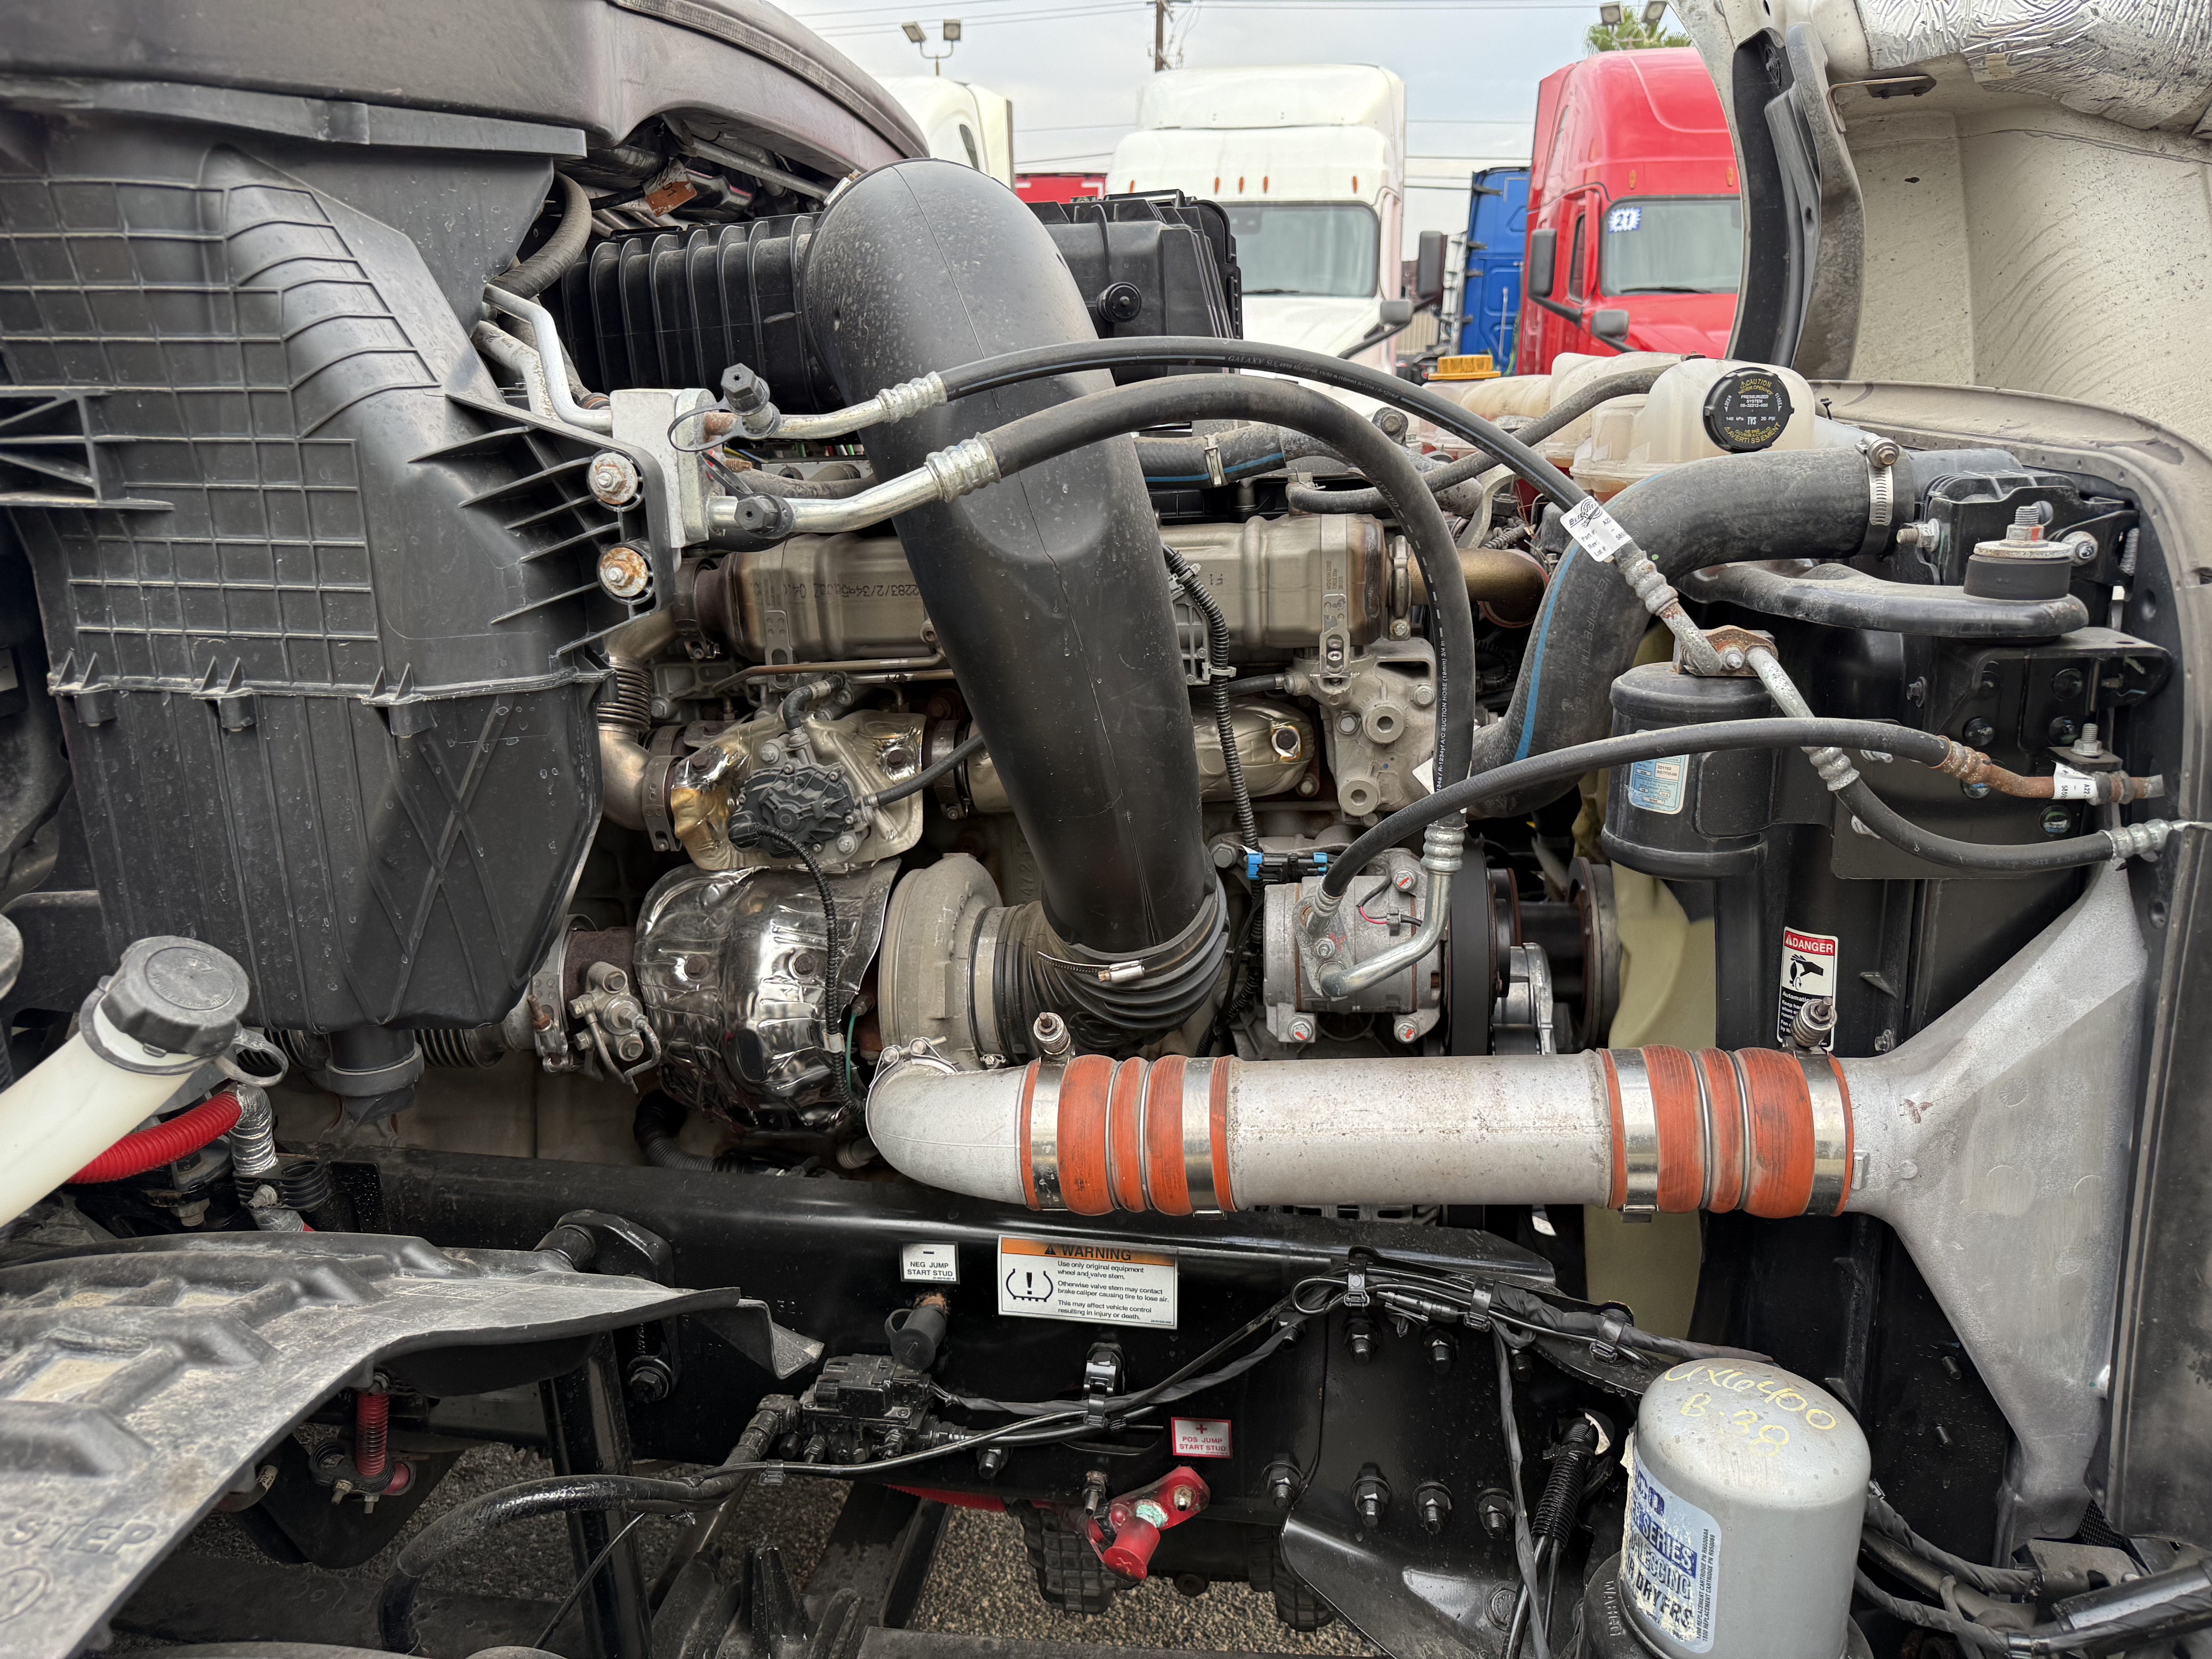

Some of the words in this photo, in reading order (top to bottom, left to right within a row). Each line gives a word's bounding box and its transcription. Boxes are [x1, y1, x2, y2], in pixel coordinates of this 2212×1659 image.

[1616, 213, 1633, 228] 21
[1228, 355, 1264, 365] GALAXY
[1746, 378, 1772, 388] CAUTION
[1747, 416, 1757, 425] TVS
[1728, 422, 1781, 443] AVERTISSEMENT
[1581, 532, 1592, 541] Part
[1792, 936, 1834, 953] DANGER
[1782, 1000, 1793, 1008] Keep
[1062, 1245, 1132, 1261] WARNING
[2, 1511, 158, 1556] STEP
[1643, 1513, 1693, 1569] SERIES
[1703, 1554, 1707, 1562] PN
[1708, 1558, 1713, 1567] PN
